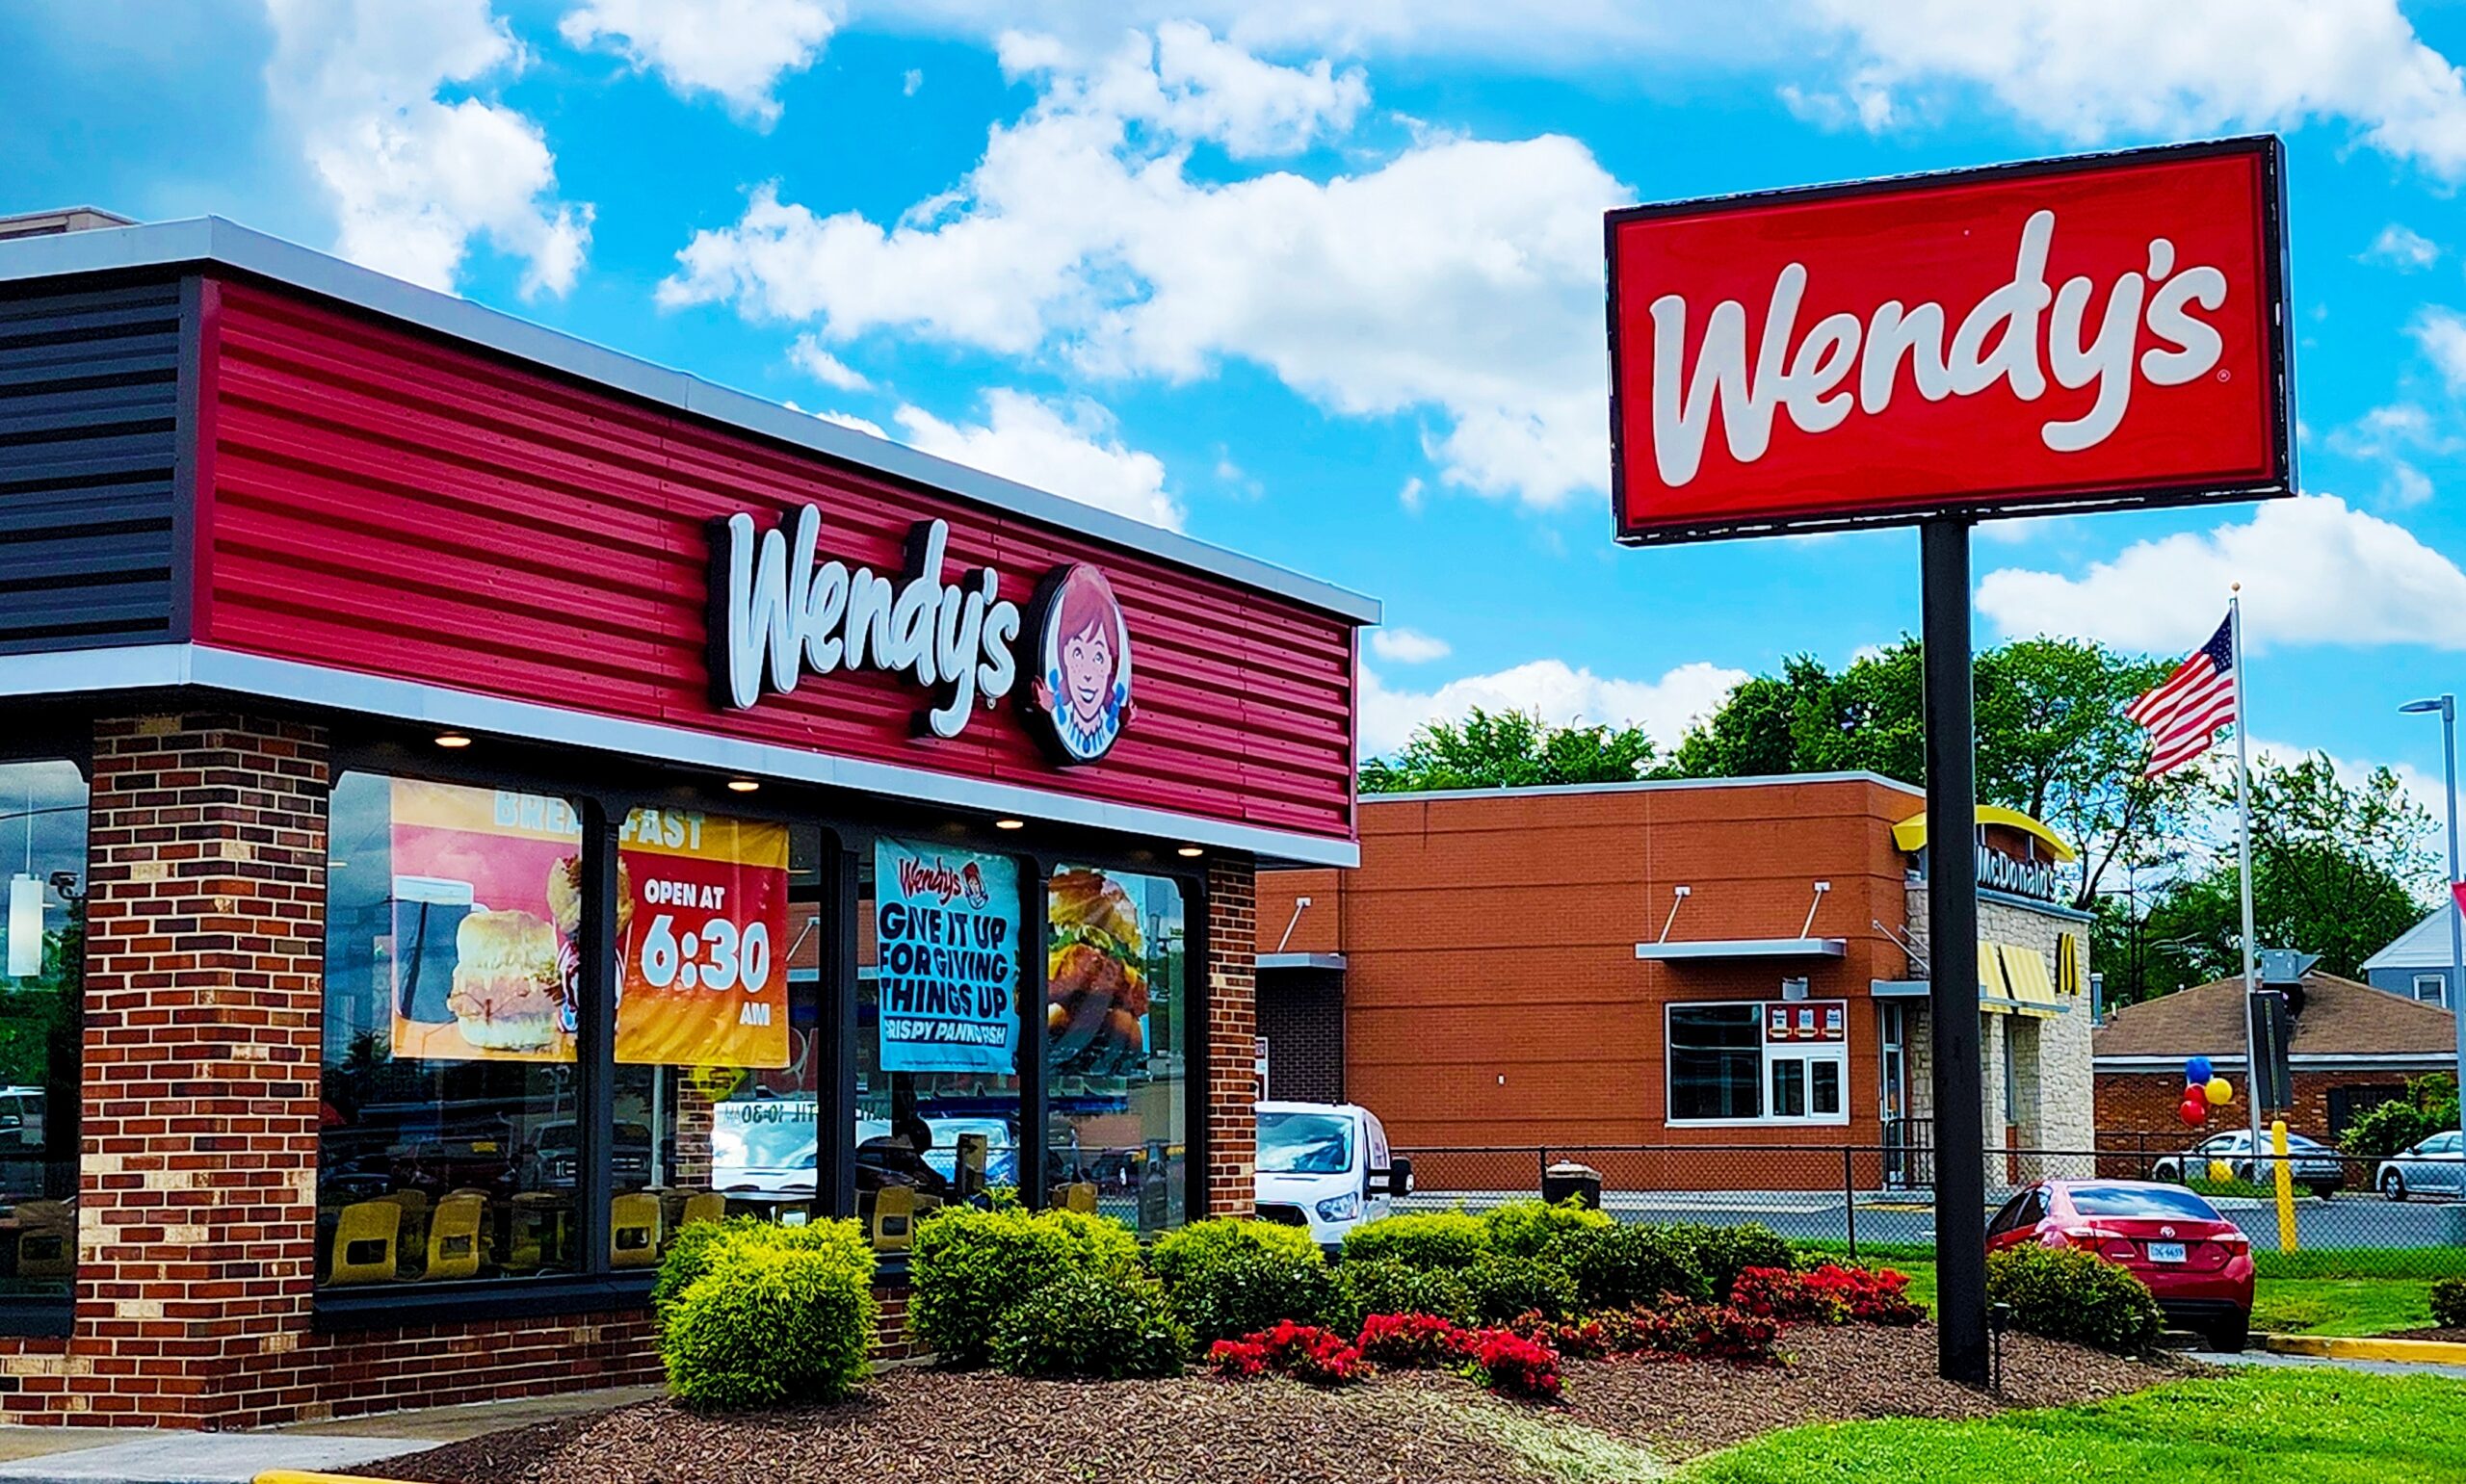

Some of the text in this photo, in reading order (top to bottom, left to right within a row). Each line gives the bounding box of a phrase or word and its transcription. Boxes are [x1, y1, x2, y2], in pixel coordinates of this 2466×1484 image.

[1649, 210, 2227, 486] Wendy's
[728, 503, 1020, 737] Wendy's
[644, 878, 724, 910] OPEN AT
[899, 856, 961, 905] Wendy's
[879, 902, 1007, 950] GIVE IT UP
[641, 914, 770, 993] 6:30
[740, 1002, 771, 1026] AM
[880, 976, 1008, 1019] THINGS UP
